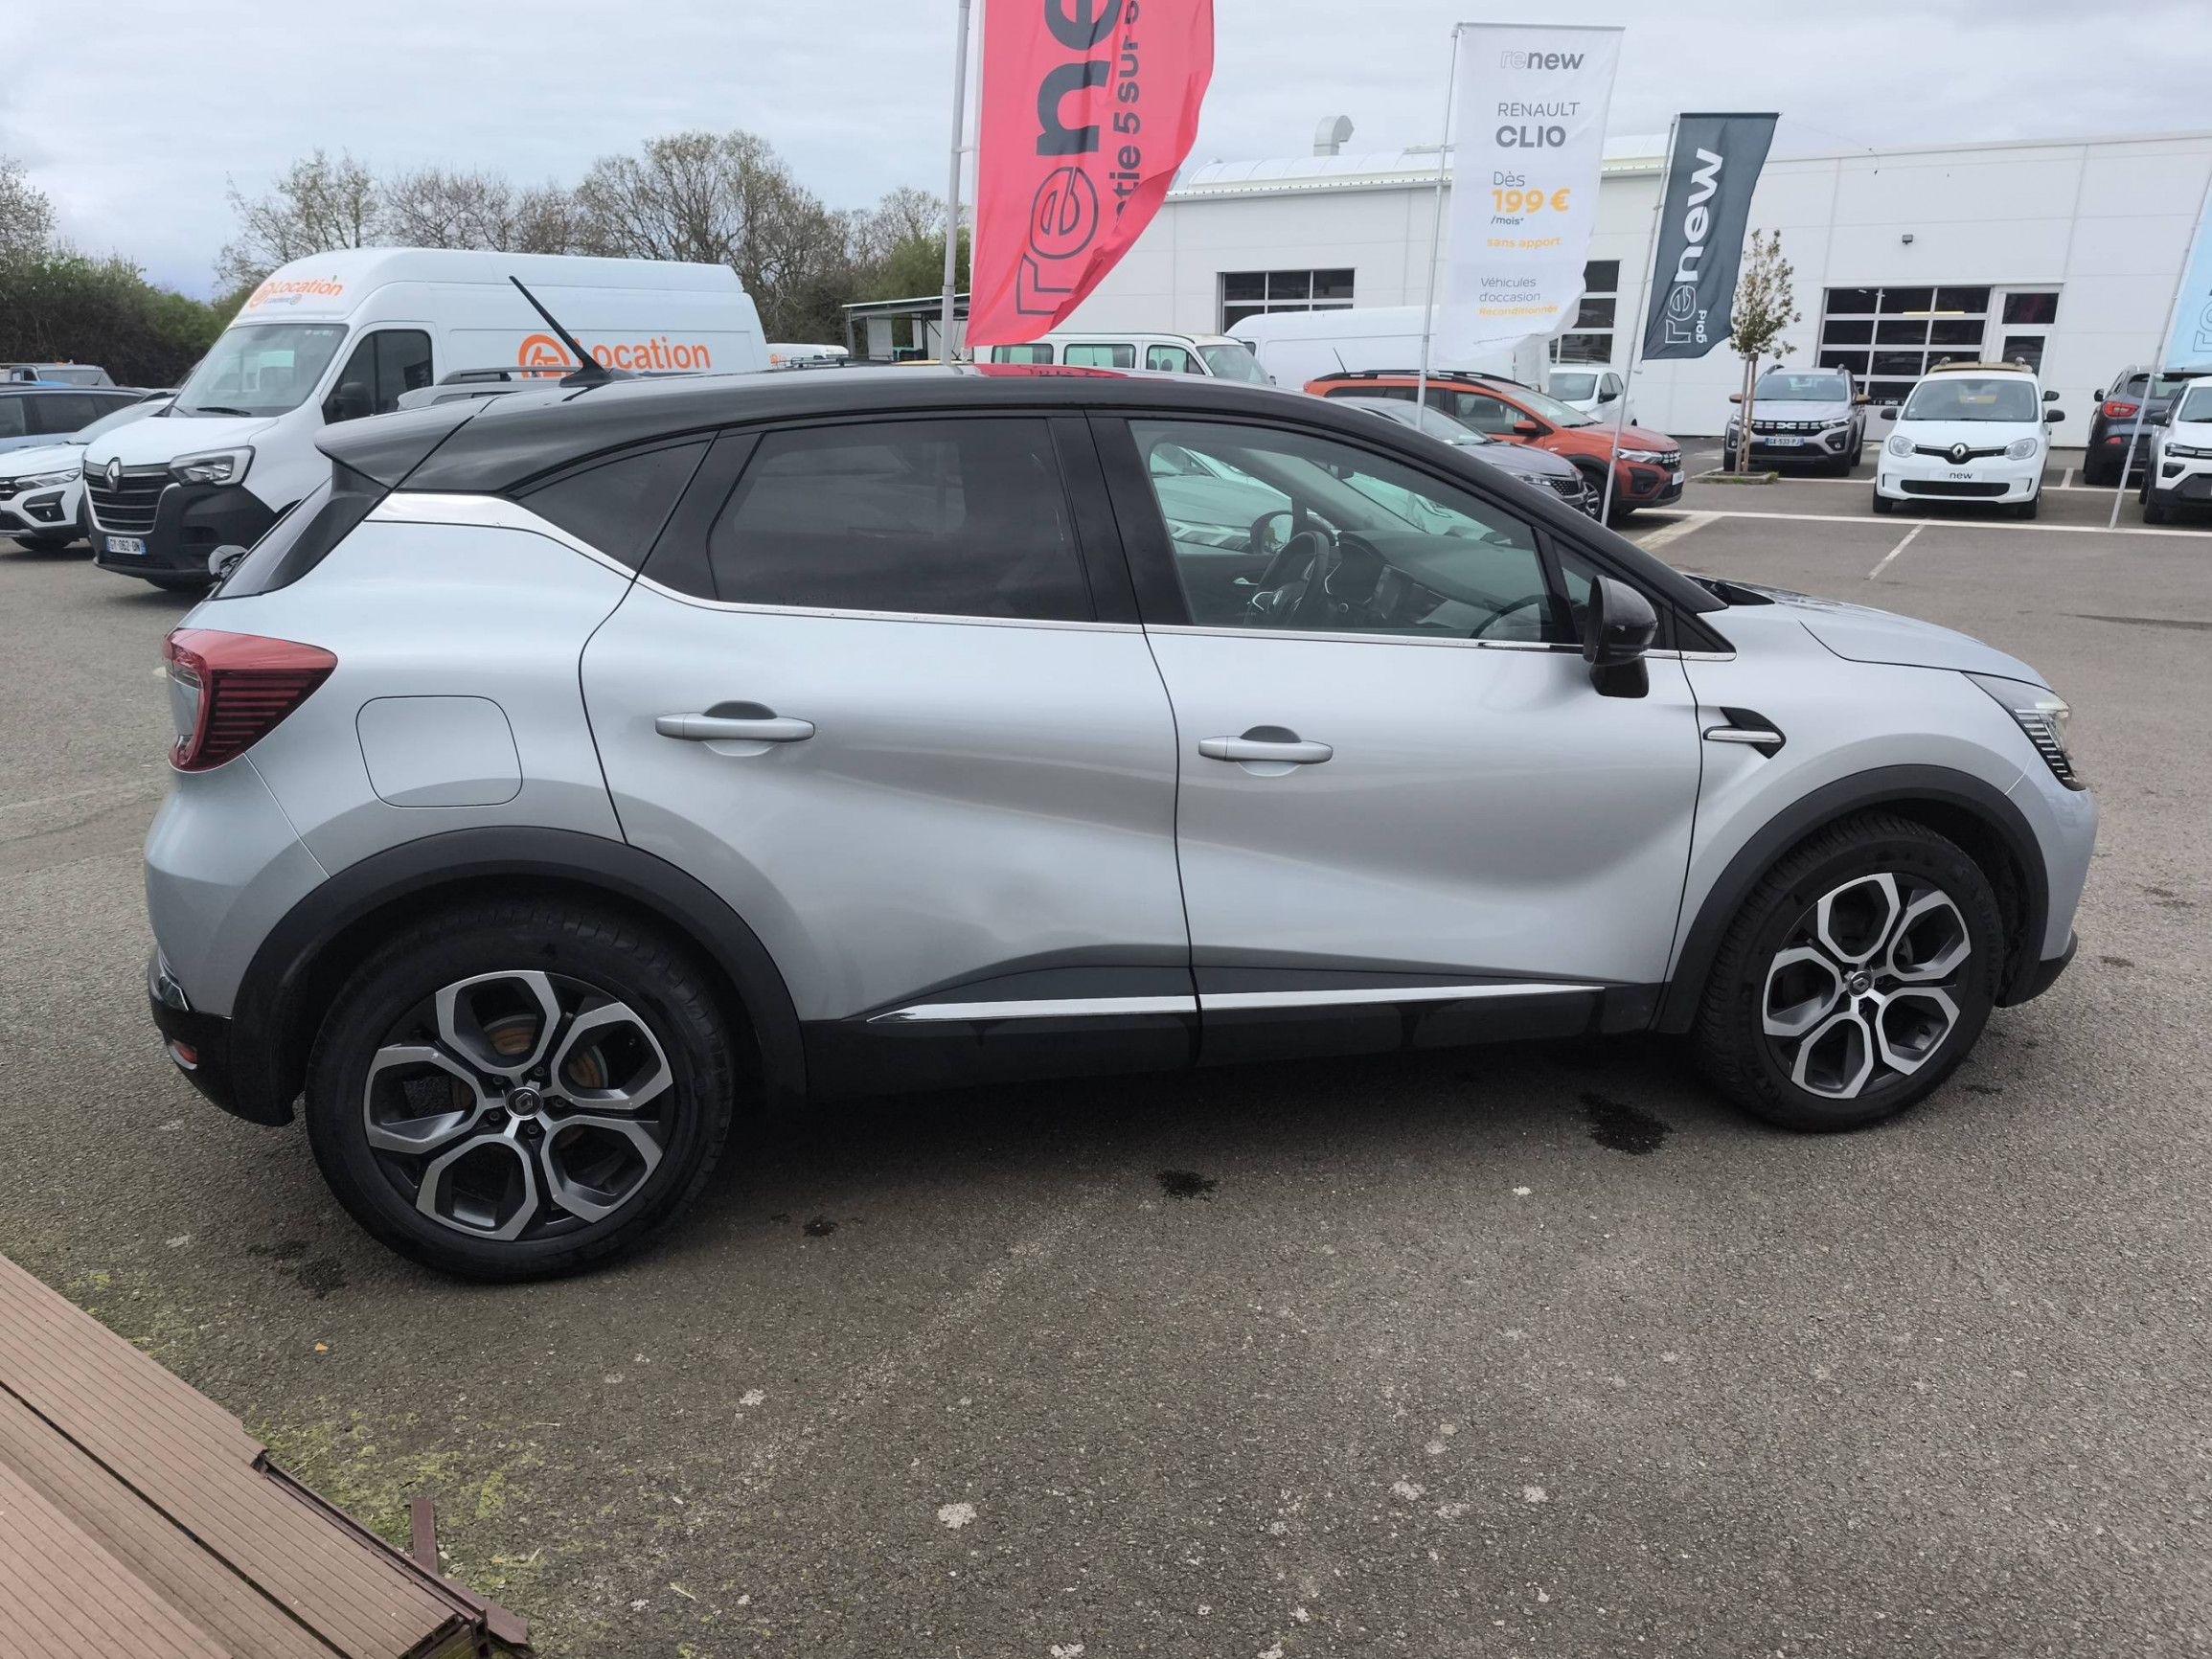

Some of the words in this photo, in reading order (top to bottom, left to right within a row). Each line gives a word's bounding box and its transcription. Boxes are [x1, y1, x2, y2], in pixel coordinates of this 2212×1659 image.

[1117, 35, 1139, 103] sur
[1500, 51, 1584, 70] renew
[1497, 102, 1580, 117] RENAULT
[1113, 112, 1140, 134] 5
[1496, 125, 1566, 148] CLIO
[1494, 170, 1525, 188] Dès
[1492, 189, 1544, 214] 199
[1549, 188, 1571, 212] €
[1487, 239, 1516, 248] sans
[1518, 237, 1562, 250] apport
[1665, 148, 1723, 344] renew
[272, 280, 343, 296] Location
[1480, 277, 1537, 288] Véhicules
[1479, 292, 1540, 303] d'occasion
[1696, 309, 1708, 344] gold
[574, 336, 711, 370] ocation
